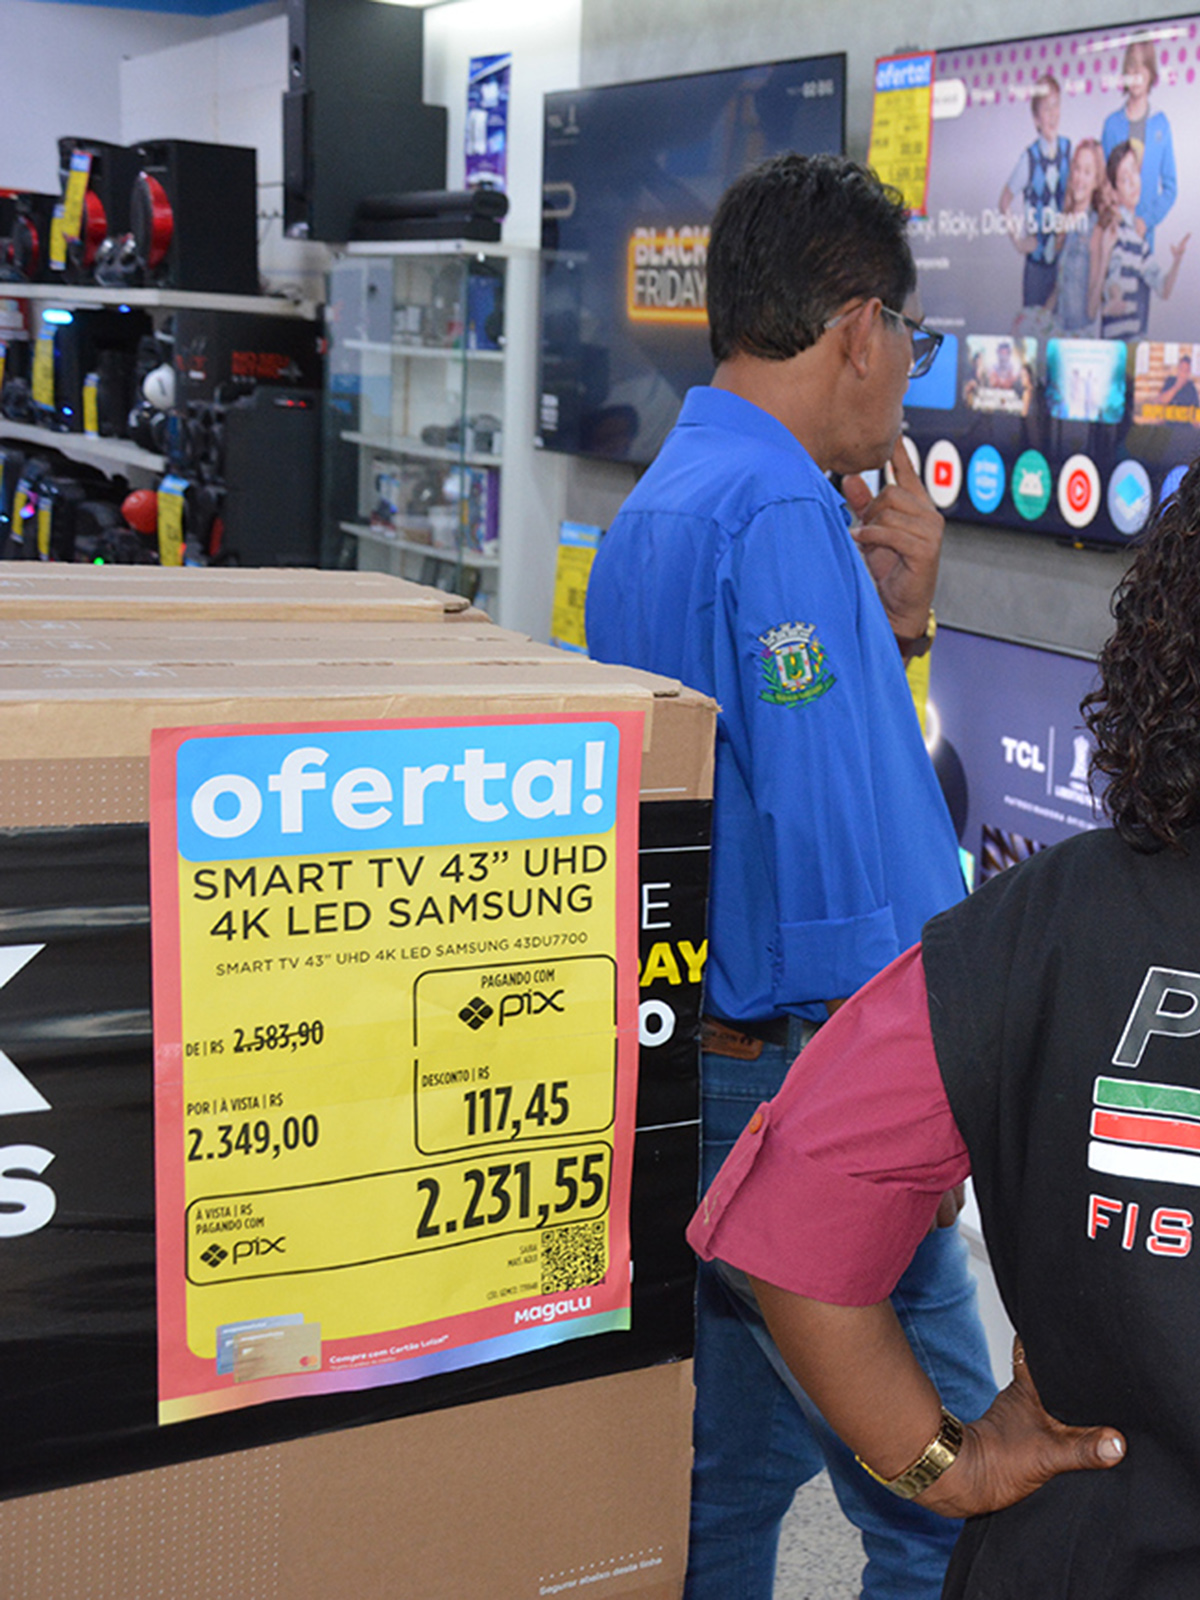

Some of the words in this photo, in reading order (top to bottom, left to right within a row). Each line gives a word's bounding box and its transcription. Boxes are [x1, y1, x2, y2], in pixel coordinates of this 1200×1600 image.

[1001, 735, 1046, 774] TCL
[190, 740, 607, 839] oferta!
[193, 860, 353, 901] SMART
[368, 856, 425, 888] TV
[524, 844, 608, 878] UHD
[209, 907, 271, 942] 4K
[286, 901, 373, 937] LED
[387, 884, 594, 930] SAMSUNG
[214, 958, 274, 977] SMART
[277, 956, 300, 970] TV
[335, 950, 371, 965] UHD
[374, 947, 397, 961] 4K
[401, 945, 432, 960] LED
[435, 938, 510, 958] SAMSUNG
[513, 931, 589, 950] 43DU7700
[480, 973, 531, 989] PAGANDO
[533, 968, 556, 984] COM
[497, 988, 566, 1028] pix
[185, 1041, 201, 1057] DE
[232, 1019, 325, 1054] 2.583,90
[421, 1069, 470, 1088] DESCONTO
[186, 1101, 210, 1116] POR
[230, 1096, 260, 1112] VISTA
[463, 1080, 570, 1141] 117,45
[187, 1113, 319, 1162] 2.349,00
[205, 1205, 232, 1219] VISTA
[416, 1152, 604, 1240] 2.231,55
[195, 1218, 243, 1235] PAGANDO
[244, 1216, 265, 1230] COM
[232, 1235, 287, 1265] pix
[329, 1352, 367, 1365] Compre
[368, 1349, 389, 1359] com
[389, 1342, 420, 1355] Cartão
